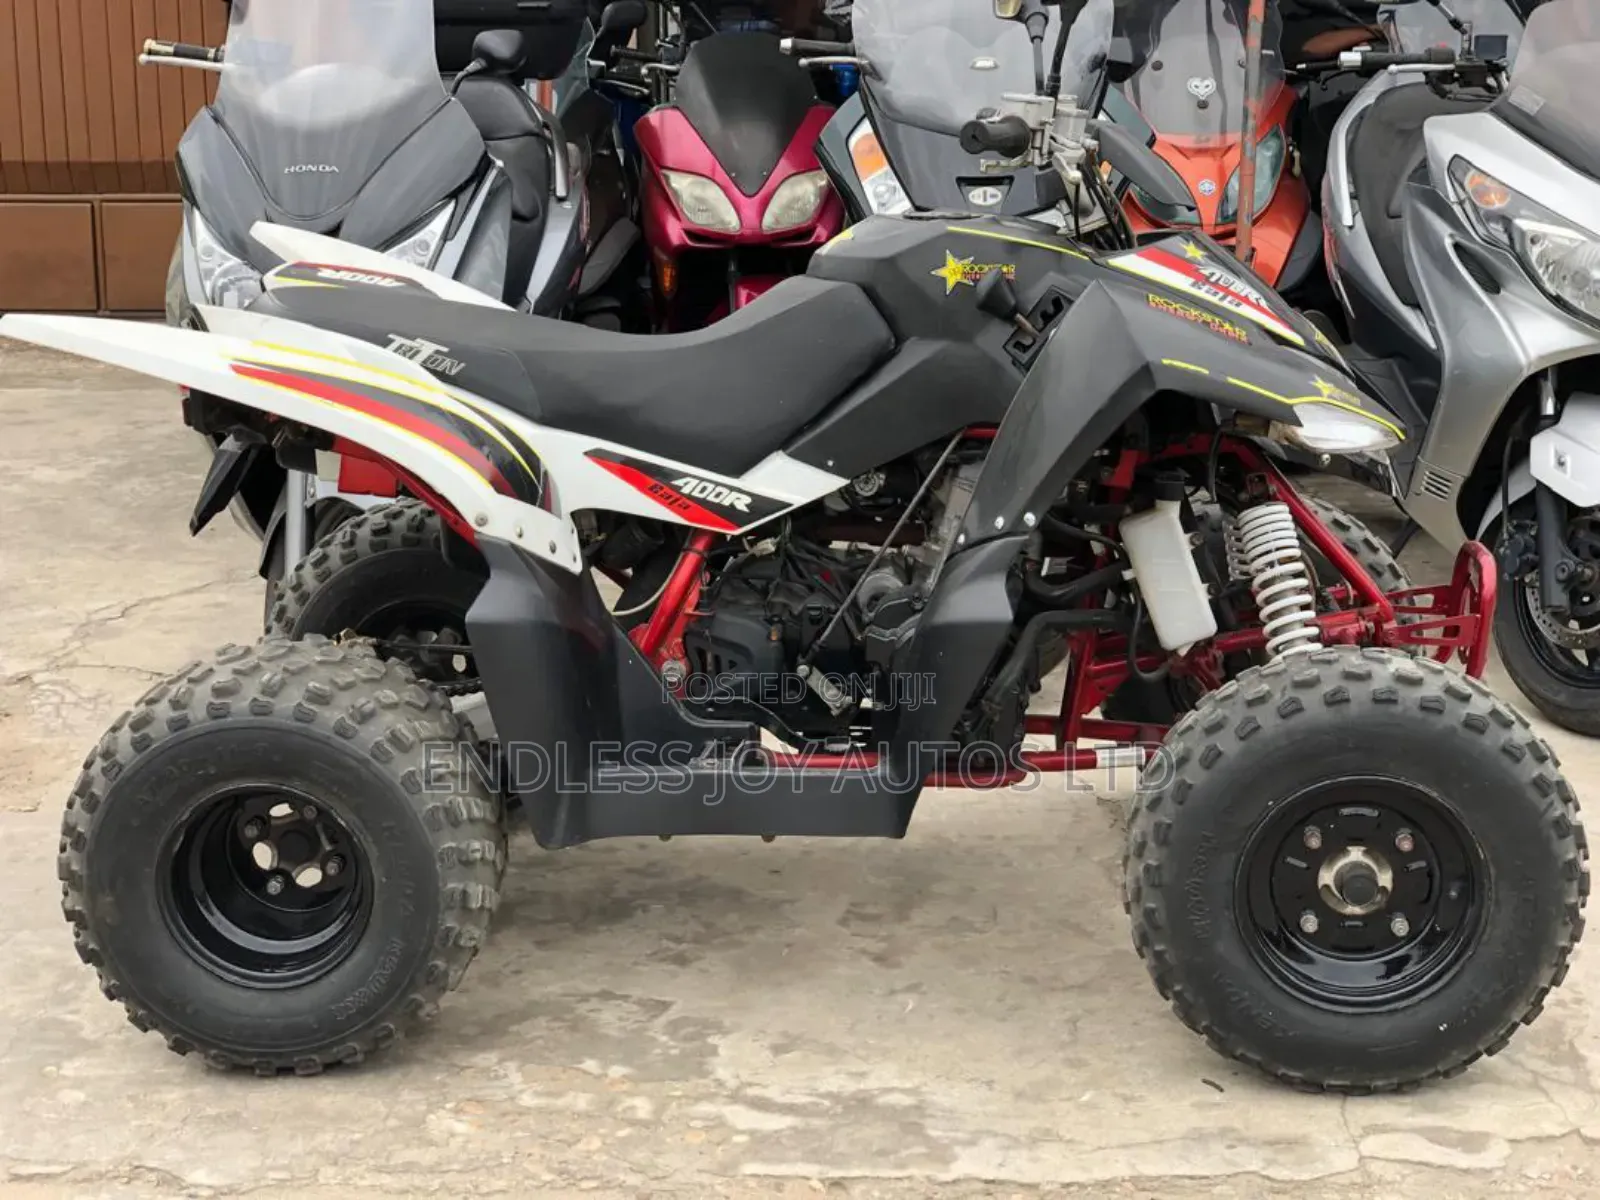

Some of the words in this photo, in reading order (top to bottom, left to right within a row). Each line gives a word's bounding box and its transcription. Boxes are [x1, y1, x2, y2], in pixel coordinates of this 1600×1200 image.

[284, 164, 339, 174] HONDA
[1147, 293, 1247, 338] ROCKSTAR
[647, 483, 693, 511] Baja
[670, 476, 753, 513] 400R
